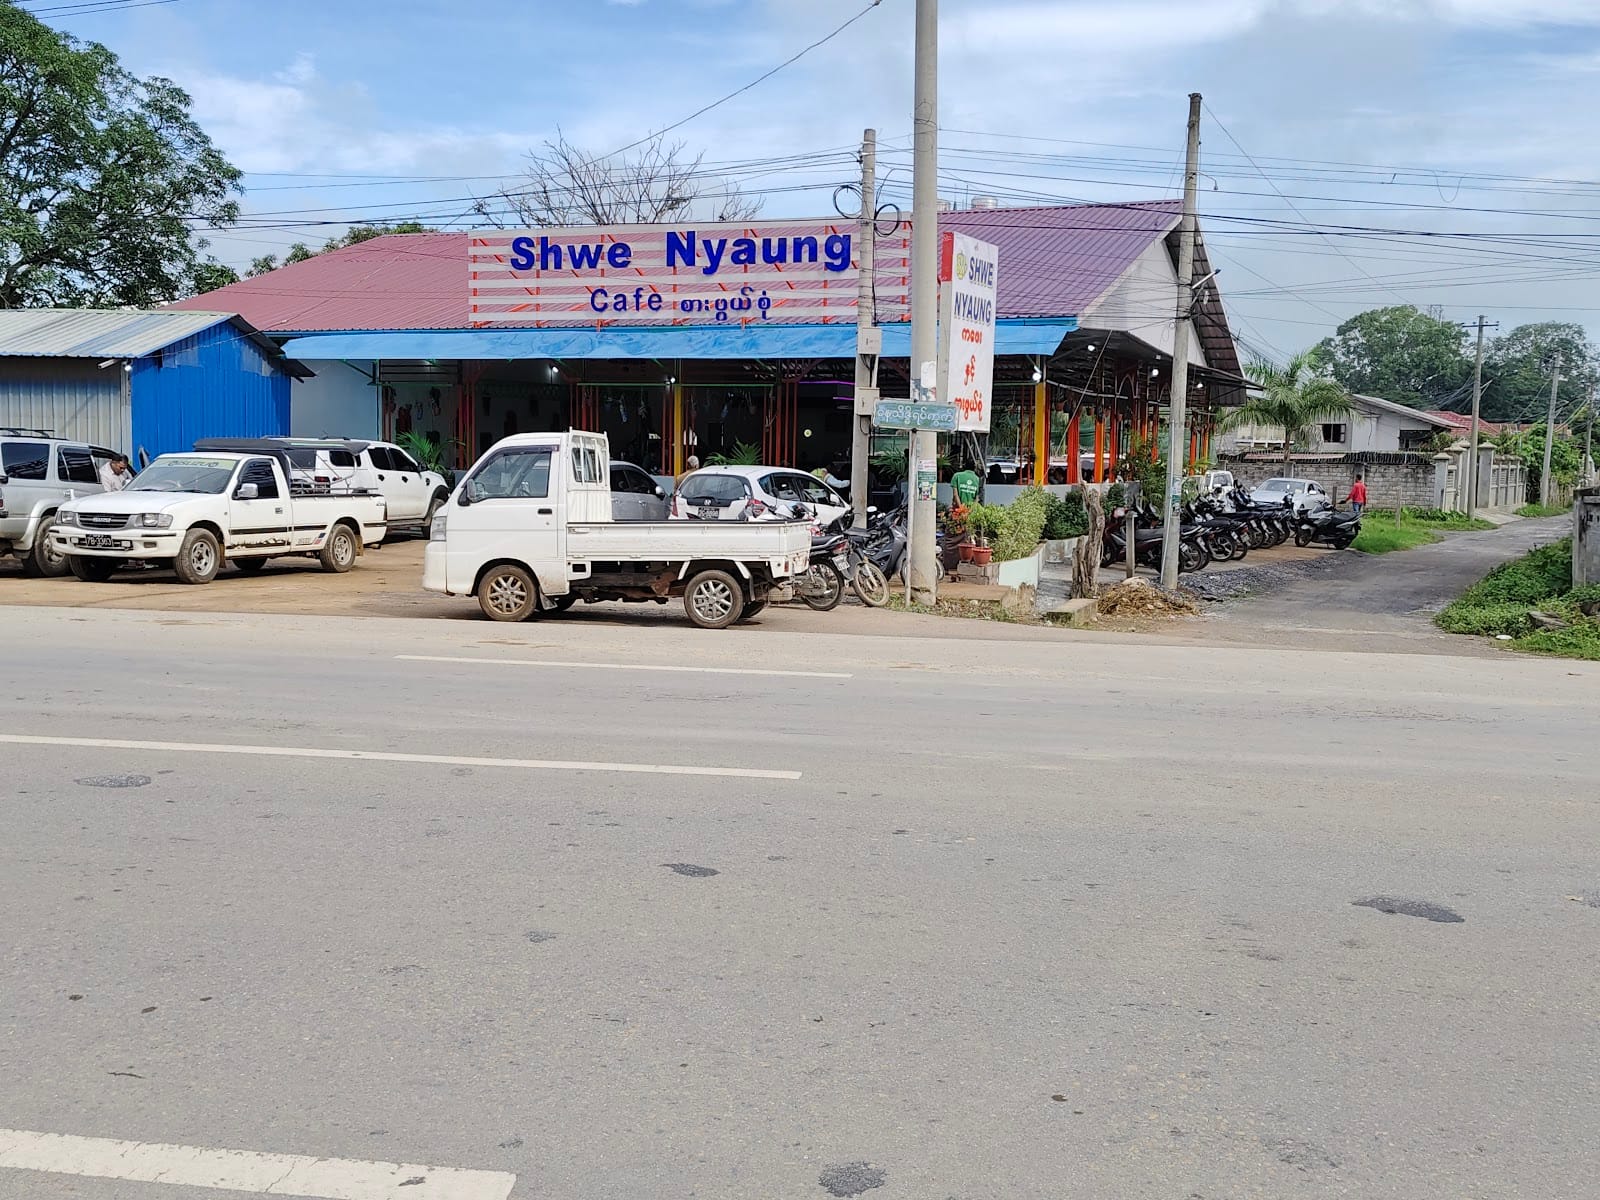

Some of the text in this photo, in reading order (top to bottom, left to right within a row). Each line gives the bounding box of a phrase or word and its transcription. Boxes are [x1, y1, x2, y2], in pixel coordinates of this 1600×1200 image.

[510, 231, 852, 276] Shwe Nyaung
[968, 256, 993, 286] SHWE
[590, 287, 663, 313] Cafe
[954, 291, 992, 323] NYAUNG
